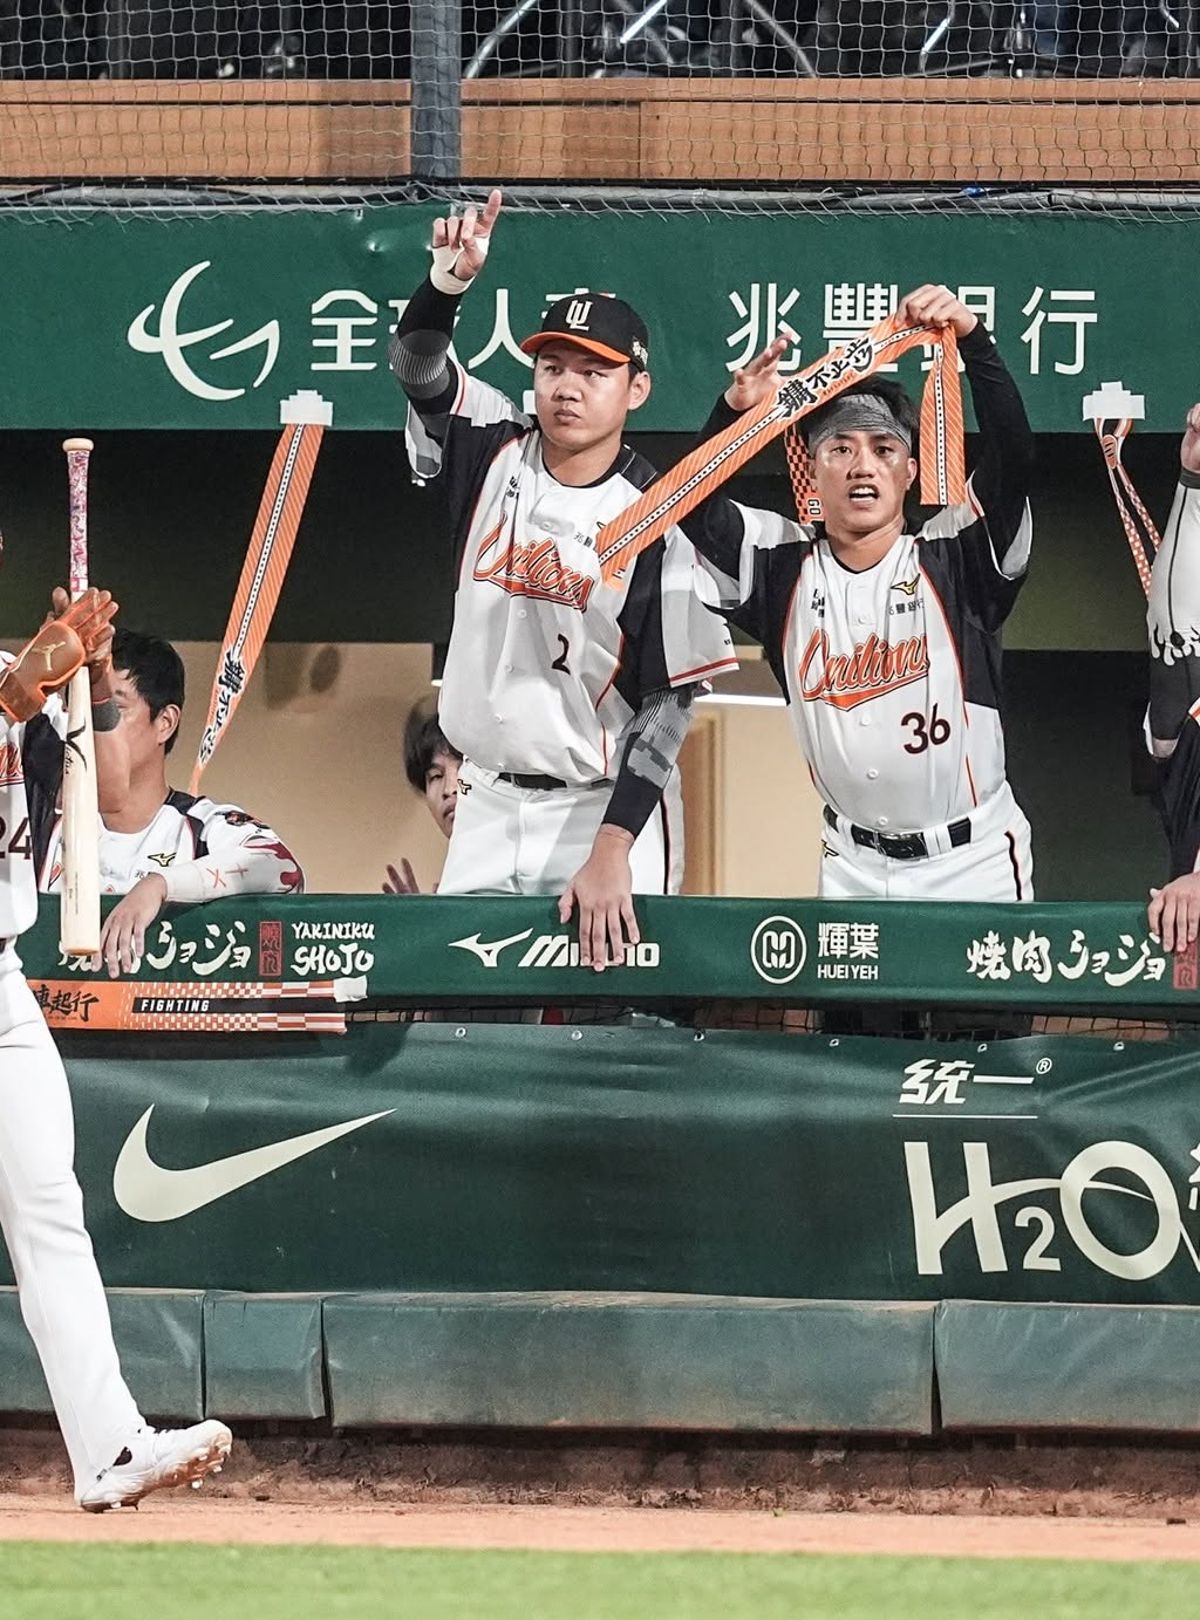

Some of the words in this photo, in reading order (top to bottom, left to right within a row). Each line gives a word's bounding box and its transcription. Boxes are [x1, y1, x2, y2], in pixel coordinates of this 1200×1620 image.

[311, 288, 616, 372] 全人
[552, 633, 571, 675] 2
[901, 703, 951, 754] 36
[58, 921, 251, 976] ショジョ
[292, 922, 375, 940] YAKINIKU
[818, 922, 879, 959] 輝葉
[290, 943, 375, 976] SHOJO
[517, 935, 660, 967] MINO
[817, 964, 849, 979] HUEI
[851, 965, 879, 980] YEH
[141, 999, 210, 1012] FIGHTING
[899, 1058, 1035, 1105] 統一
[903, 1140, 1182, 1281] H2O
